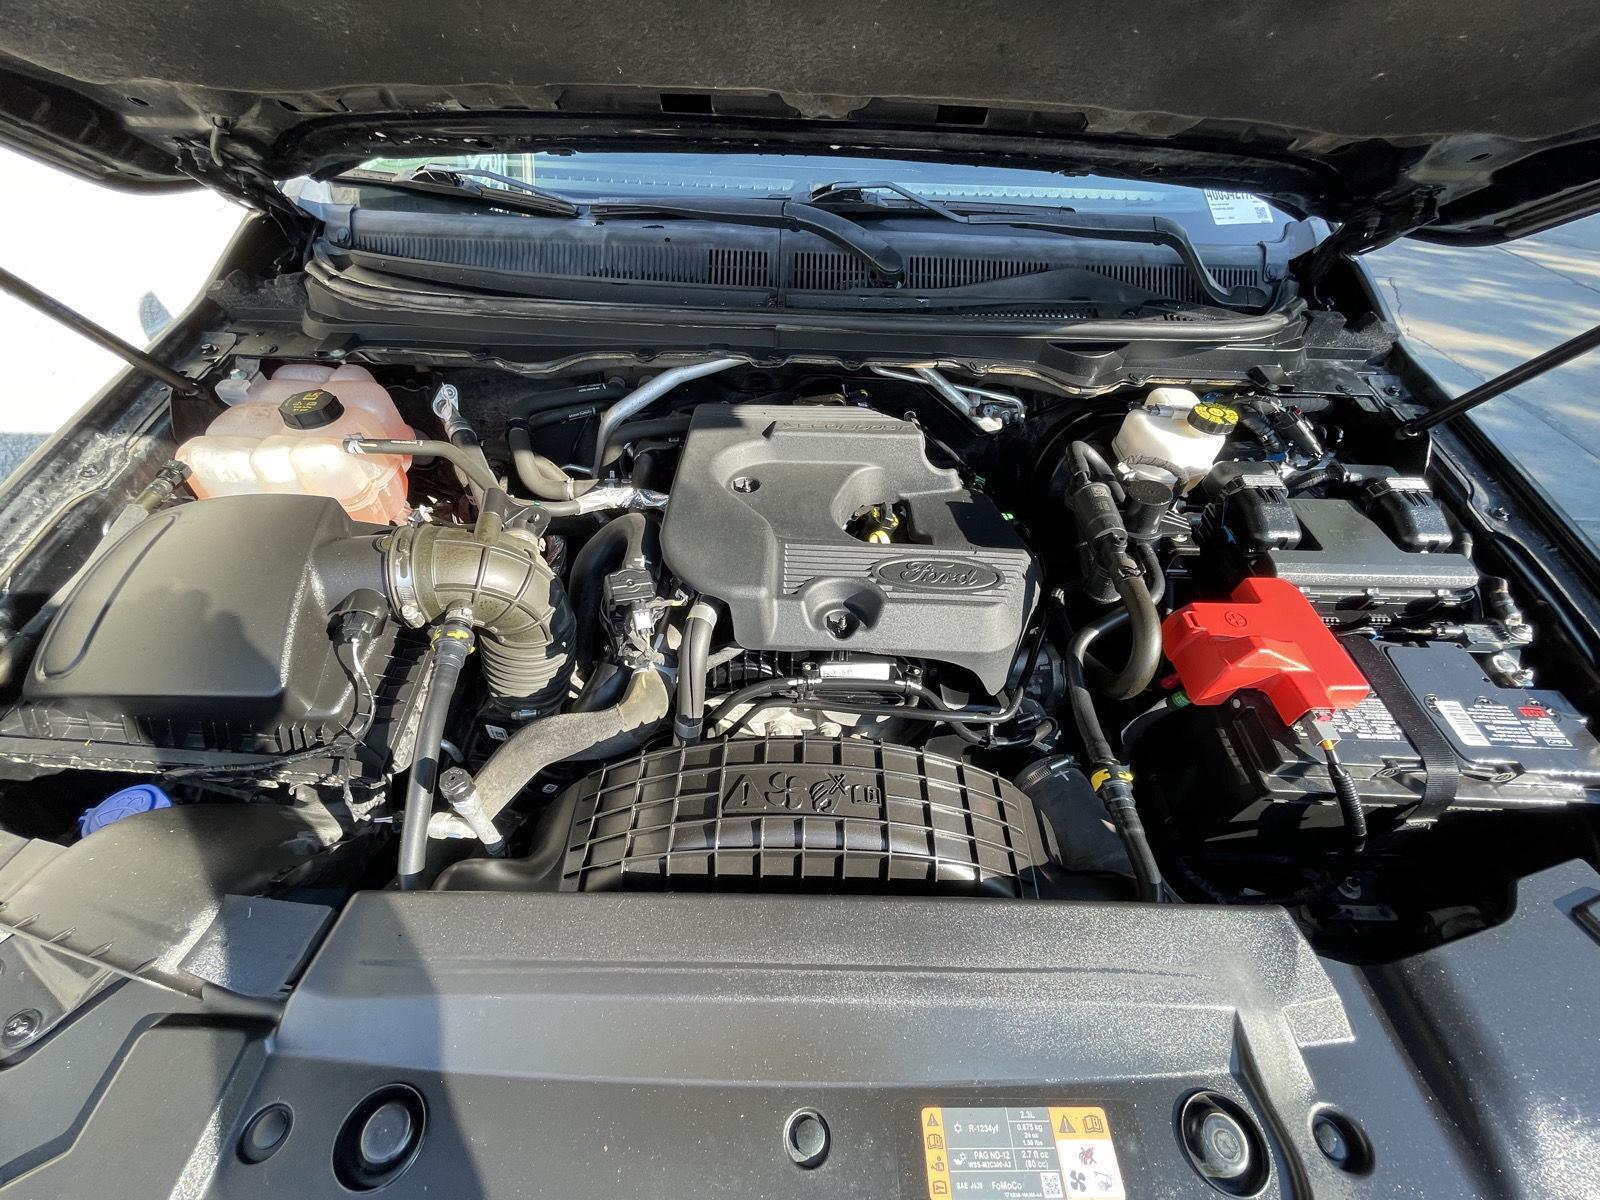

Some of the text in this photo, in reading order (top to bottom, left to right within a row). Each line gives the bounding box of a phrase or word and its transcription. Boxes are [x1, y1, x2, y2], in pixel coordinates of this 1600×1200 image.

[900, 562, 978, 586] Ford
[968, 1124, 999, 1134] R-1234yf
[974, 1151, 1010, 1159] PAG ND-12
[1021, 1150, 1032, 1159] 2.7
[1040, 1151, 1049, 1159] oz
[1037, 1160, 1049, 1169] cc)
[991, 1181, 1023, 1190] FoMoCo
